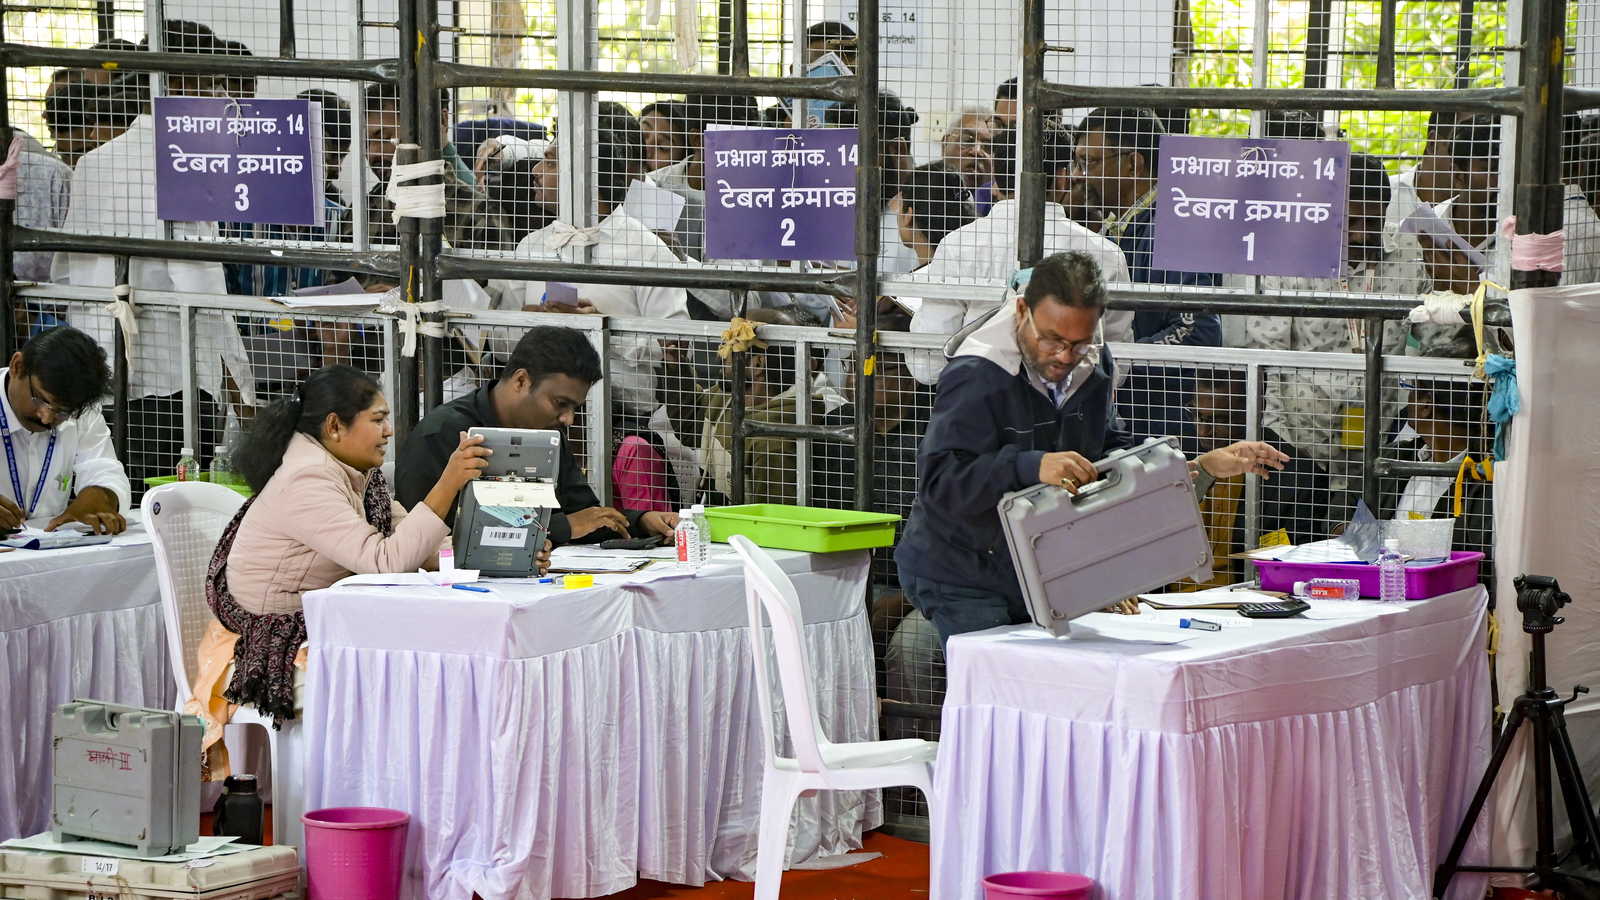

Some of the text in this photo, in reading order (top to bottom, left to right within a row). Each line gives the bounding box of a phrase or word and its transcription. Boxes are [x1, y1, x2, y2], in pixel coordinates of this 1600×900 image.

[903, 12, 916, 22] 14
[165, 111, 304, 135] प्रभाग क्रमांक. 14
[168, 144, 304, 175] टेबल क्रमांक
[715, 142, 859, 168] प्रभाग क्रमांक. 14
[1170, 153, 1336, 181] प्रभाग क्रमांक. 14
[234, 183, 250, 211] 3
[717, 178, 856, 209] टेबल क्रमांक
[1171, 187, 1332, 223] टेबल क्रमांक
[780, 218, 796, 247] 2
[1242, 232, 1255, 261] 1
[96, 862, 113, 872] 14/17
